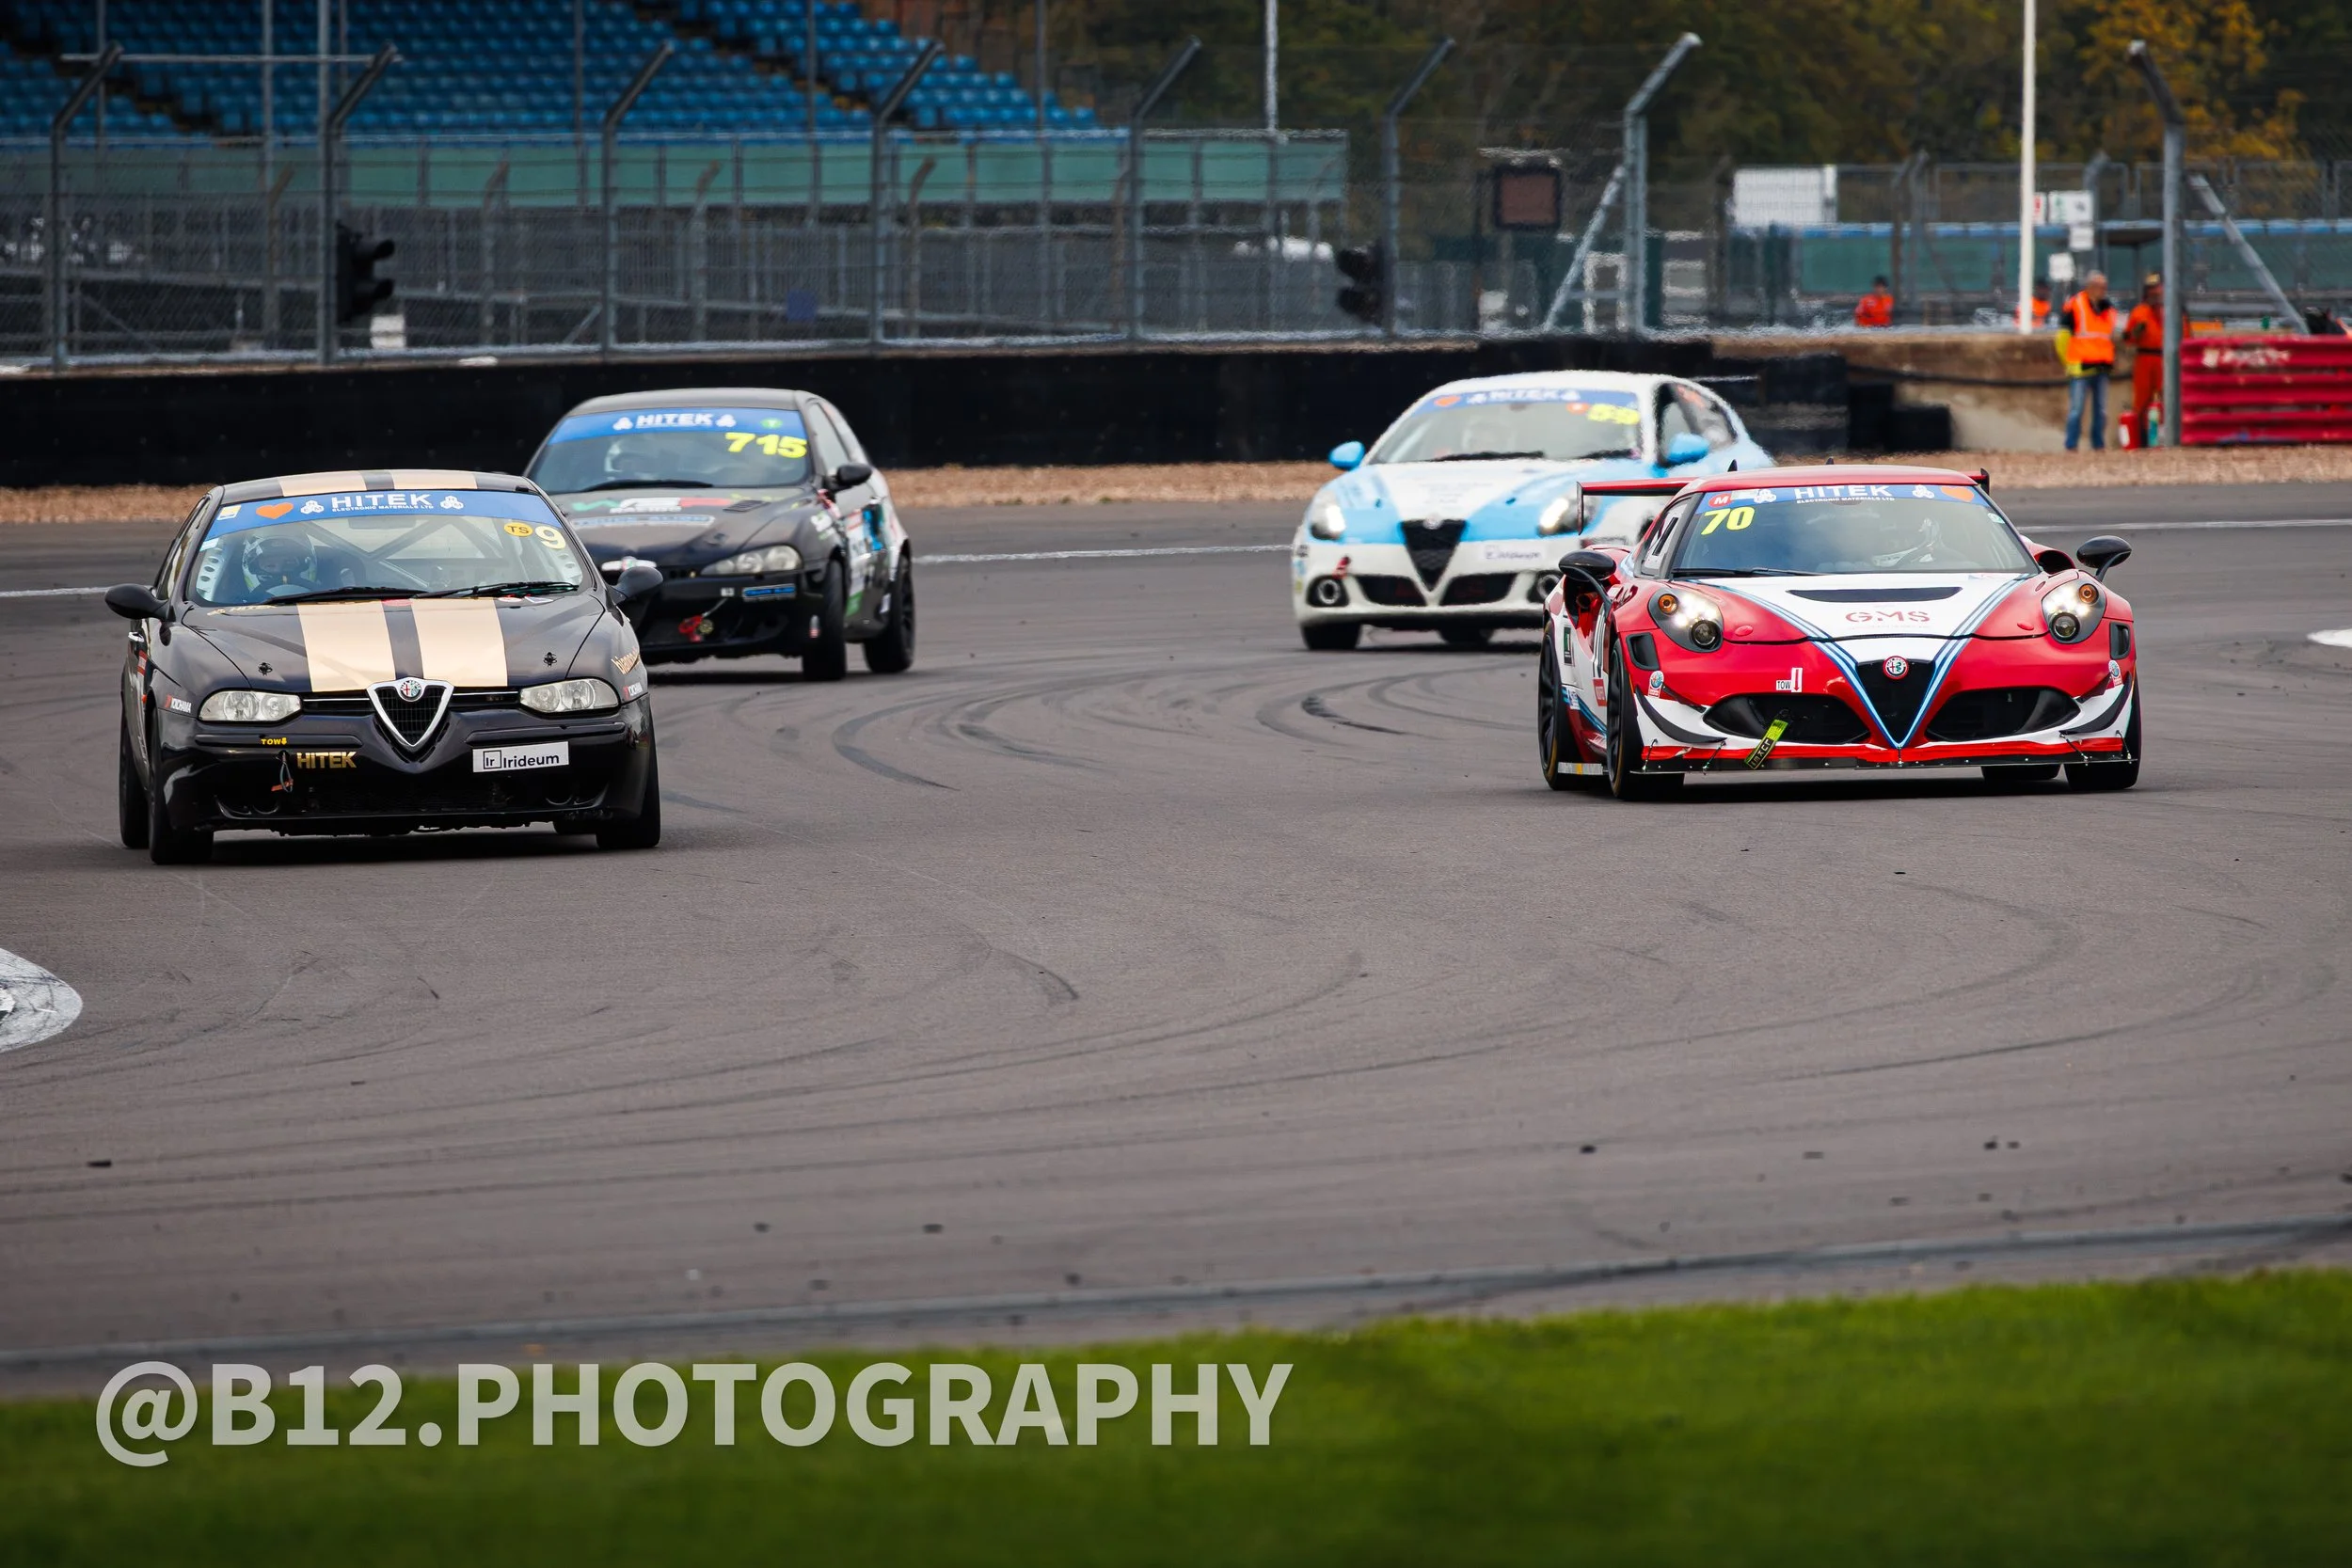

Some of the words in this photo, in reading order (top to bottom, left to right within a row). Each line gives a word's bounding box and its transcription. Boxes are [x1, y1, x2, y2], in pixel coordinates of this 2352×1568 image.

[637, 414, 712, 427] HITEK
[725, 432, 807, 458] 715
[1794, 485, 1893, 499] HITEK
[332, 494, 432, 508] HITEK
[1714, 496, 1729, 504] M
[1701, 506, 1755, 535] 70
[535, 526, 565, 549] 9
[1846, 611, 1930, 622] GMS
[1777, 681, 1790, 689] TOW
[296, 752, 357, 768] HITEK
[503, 755, 559, 768] Irideum
